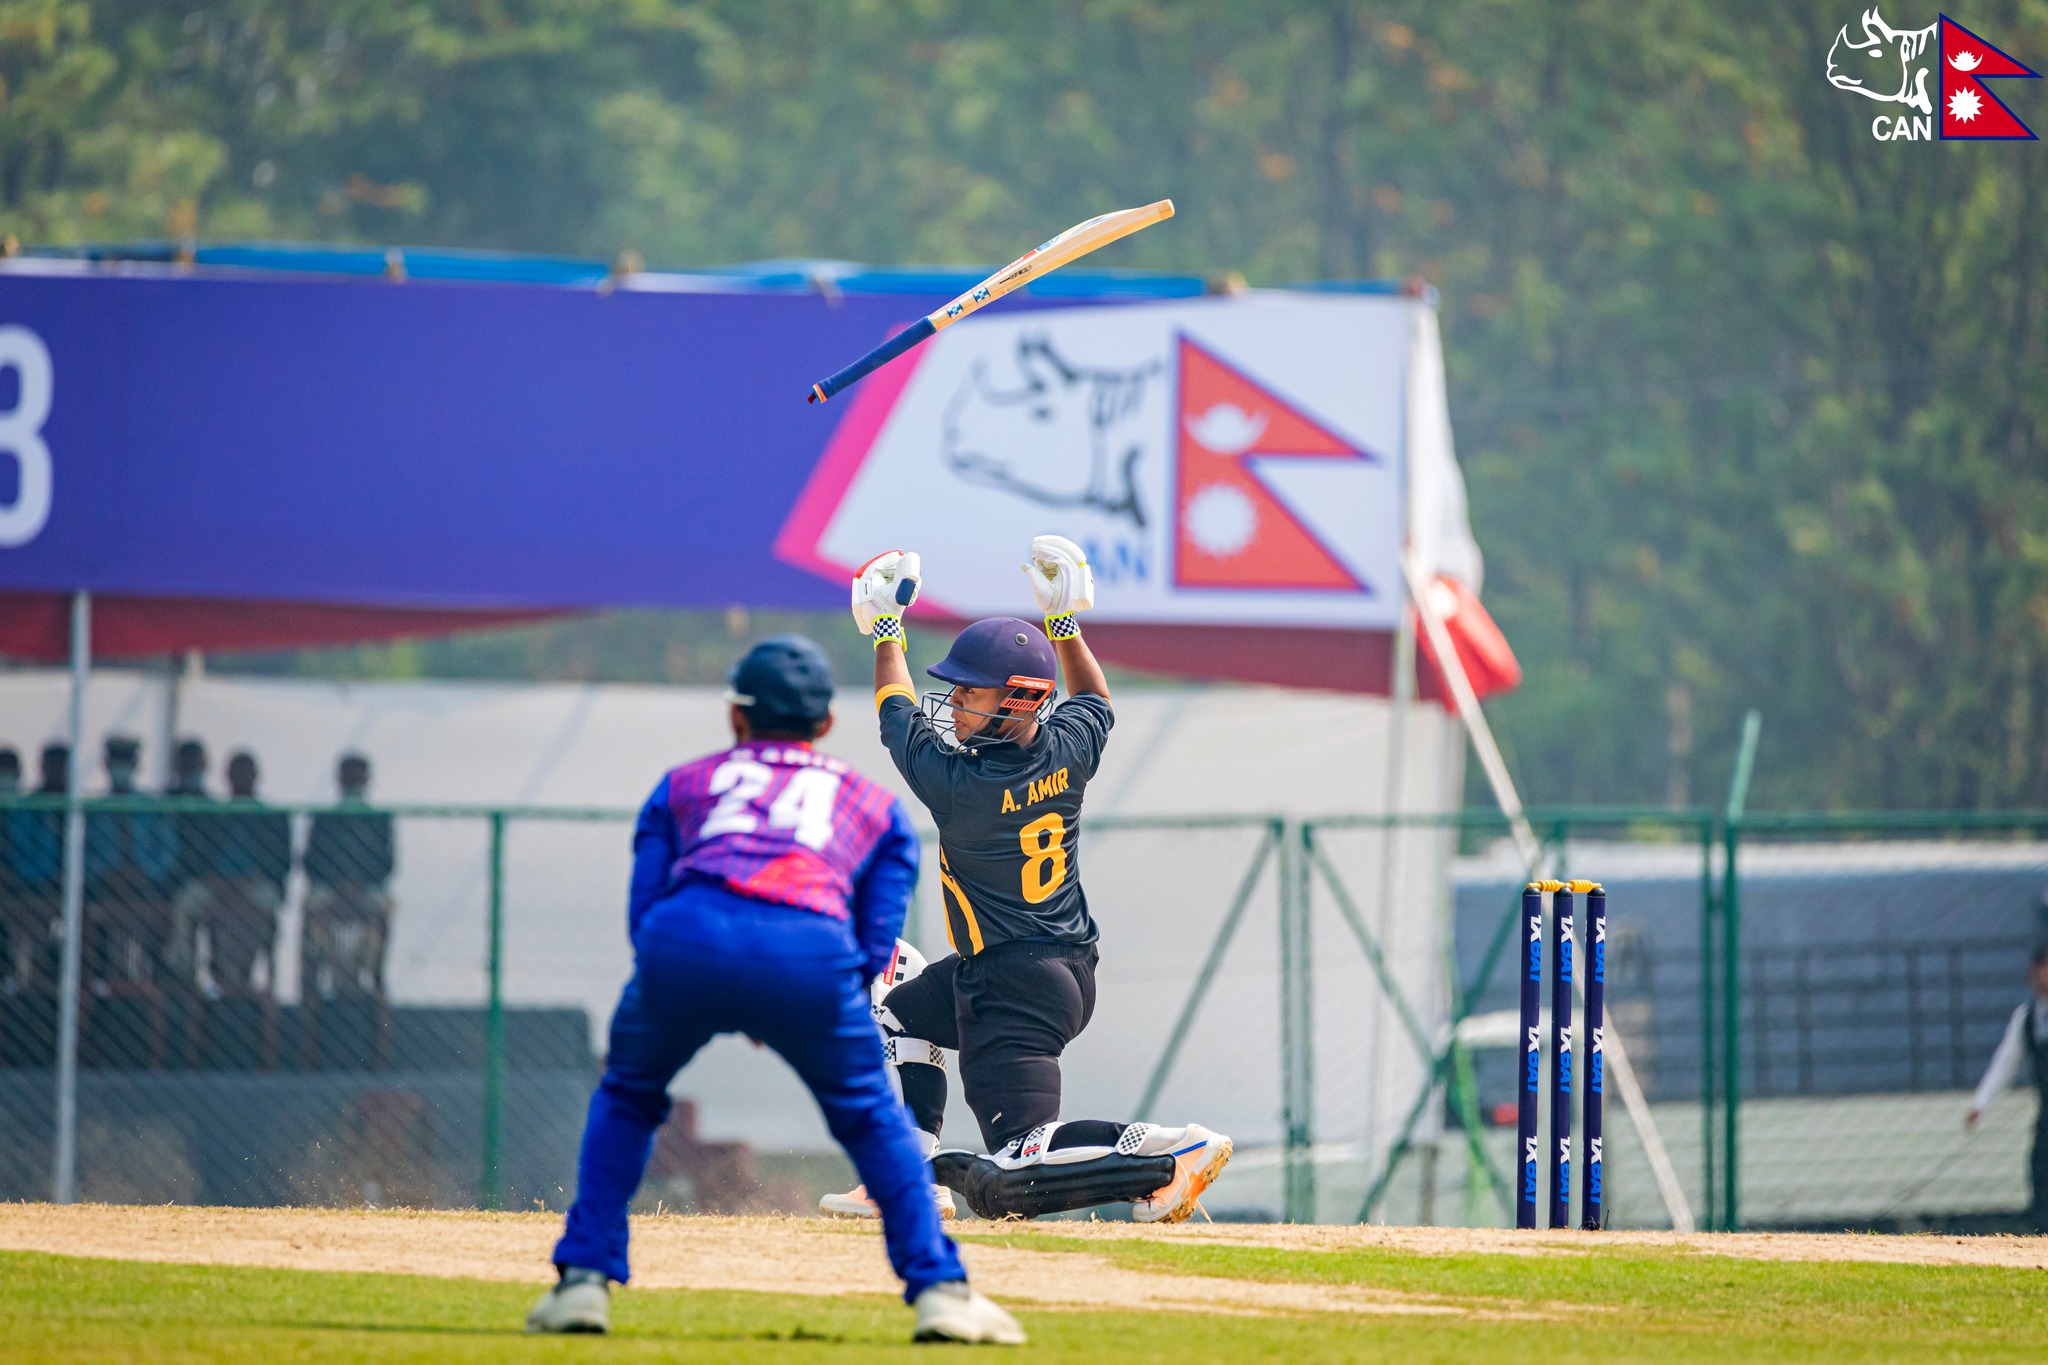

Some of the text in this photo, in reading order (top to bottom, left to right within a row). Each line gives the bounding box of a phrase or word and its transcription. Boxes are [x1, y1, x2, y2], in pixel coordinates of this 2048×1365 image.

[699, 761, 842, 852] 24
[1001, 767, 1070, 814] A. AMIR
[1018, 812, 1068, 905] 8
